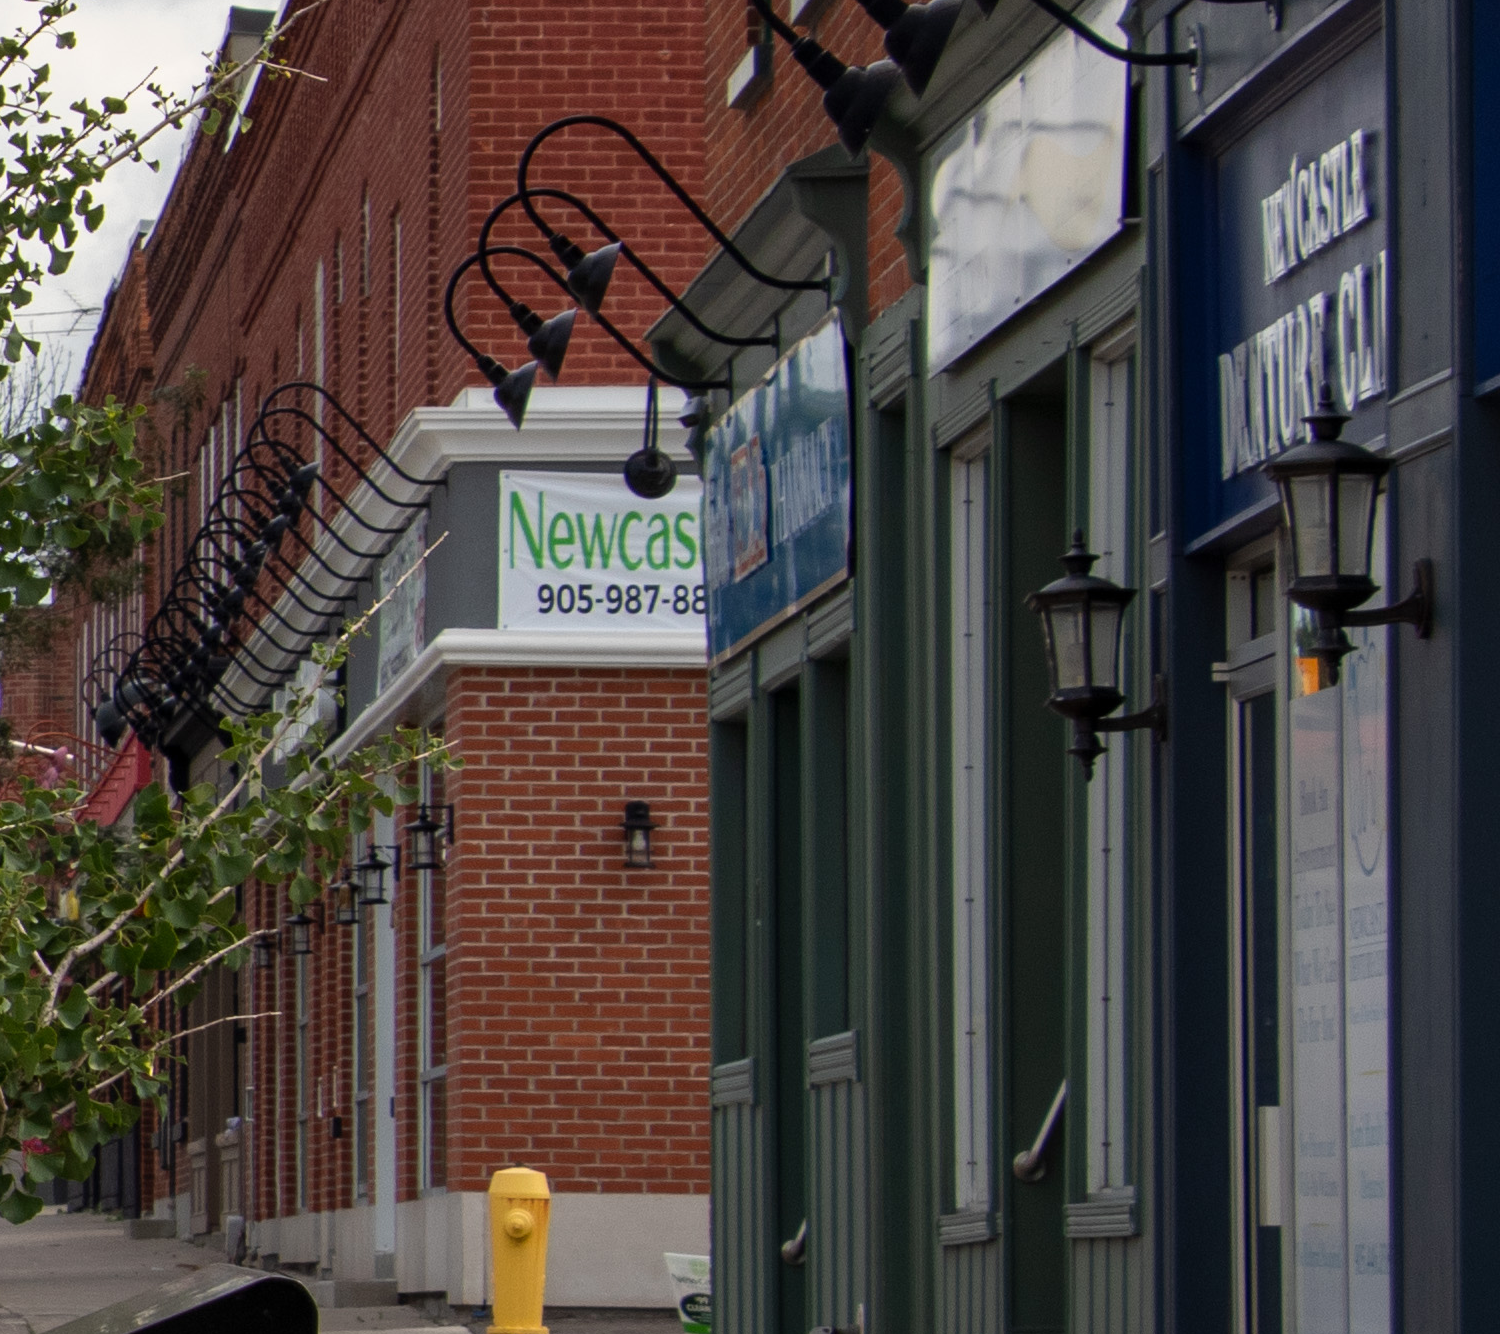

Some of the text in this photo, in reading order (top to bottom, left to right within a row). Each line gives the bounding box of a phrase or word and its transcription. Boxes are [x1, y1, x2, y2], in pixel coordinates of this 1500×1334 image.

[1261, 127, 1370, 287] NEWCASTLE
[1218, 291, 1328, 481] DENTURE
[509, 491, 700, 571] Newcas
[537, 584, 707, 615] 905-987-88
